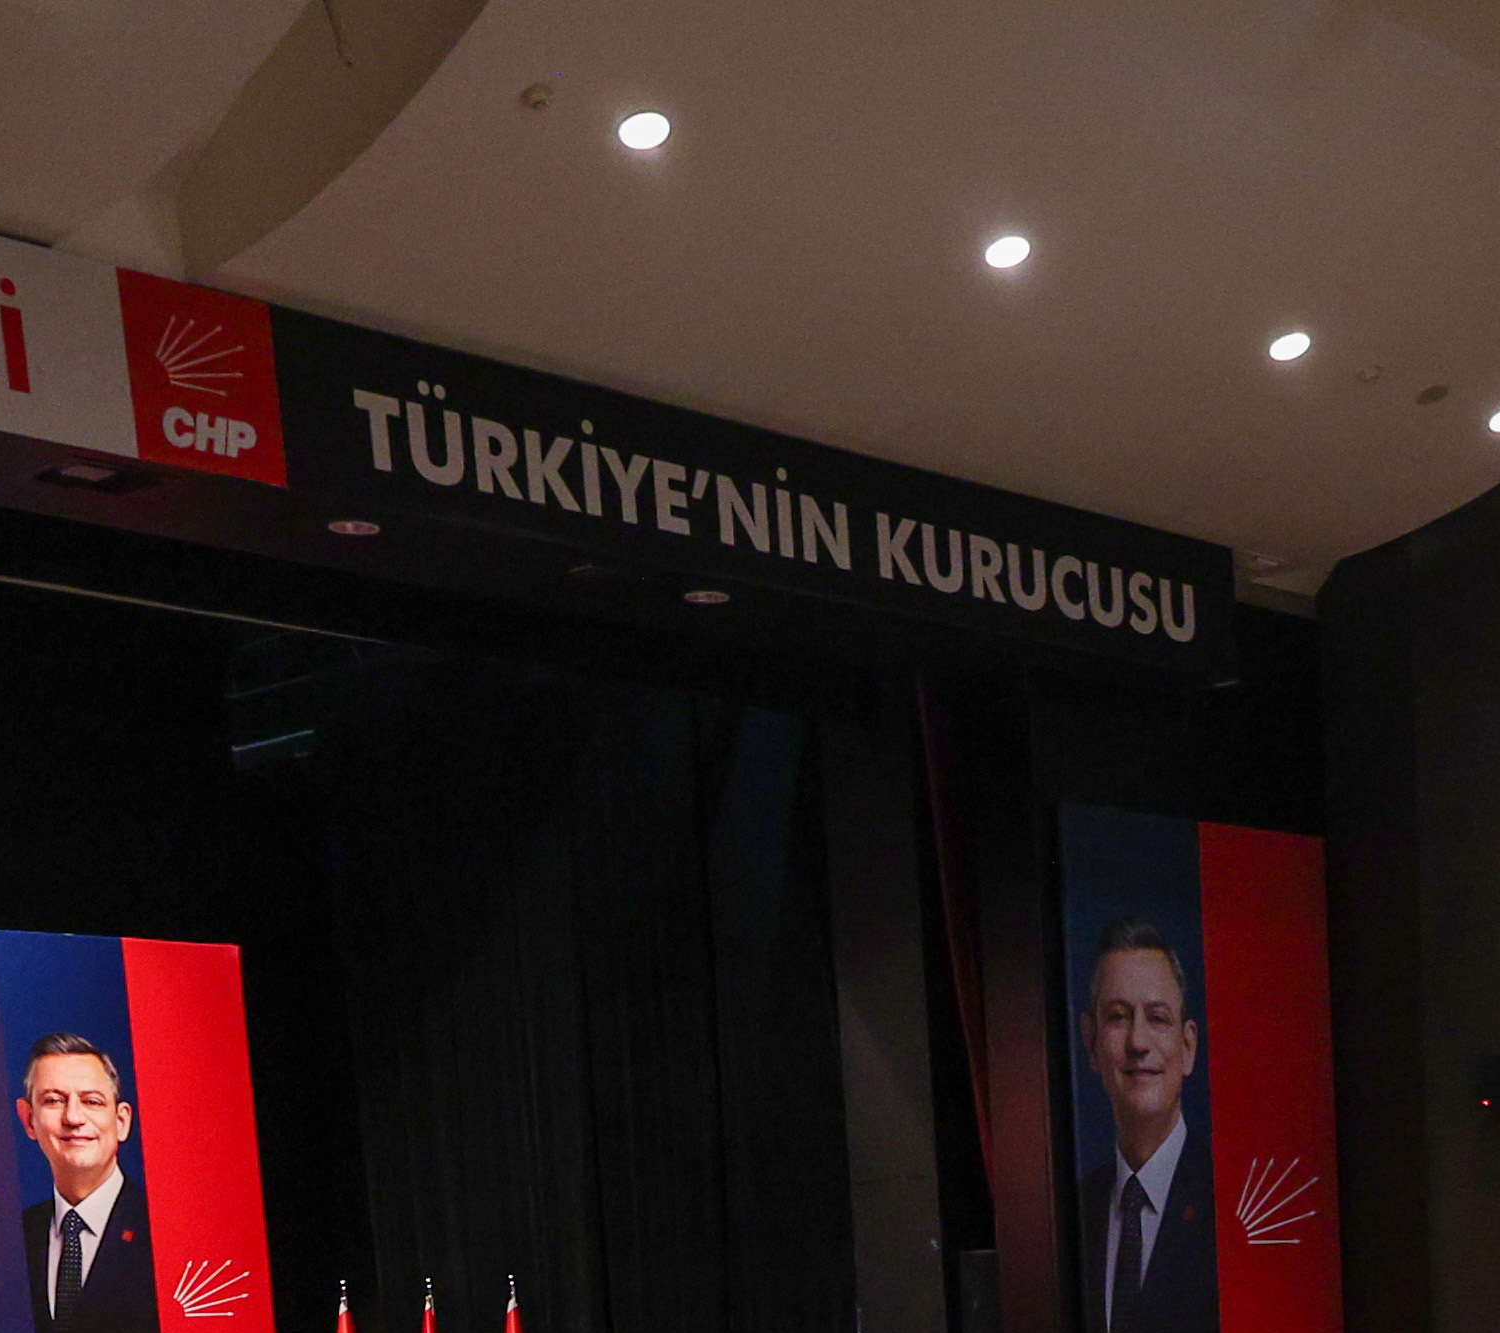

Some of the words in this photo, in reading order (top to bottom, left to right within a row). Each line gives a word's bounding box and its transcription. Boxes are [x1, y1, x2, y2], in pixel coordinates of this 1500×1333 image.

[162, 406, 258, 458] CHP
[353, 380, 853, 572] TÜRKİYE'NİN
[876, 511, 1196, 644] KURUCUSU
